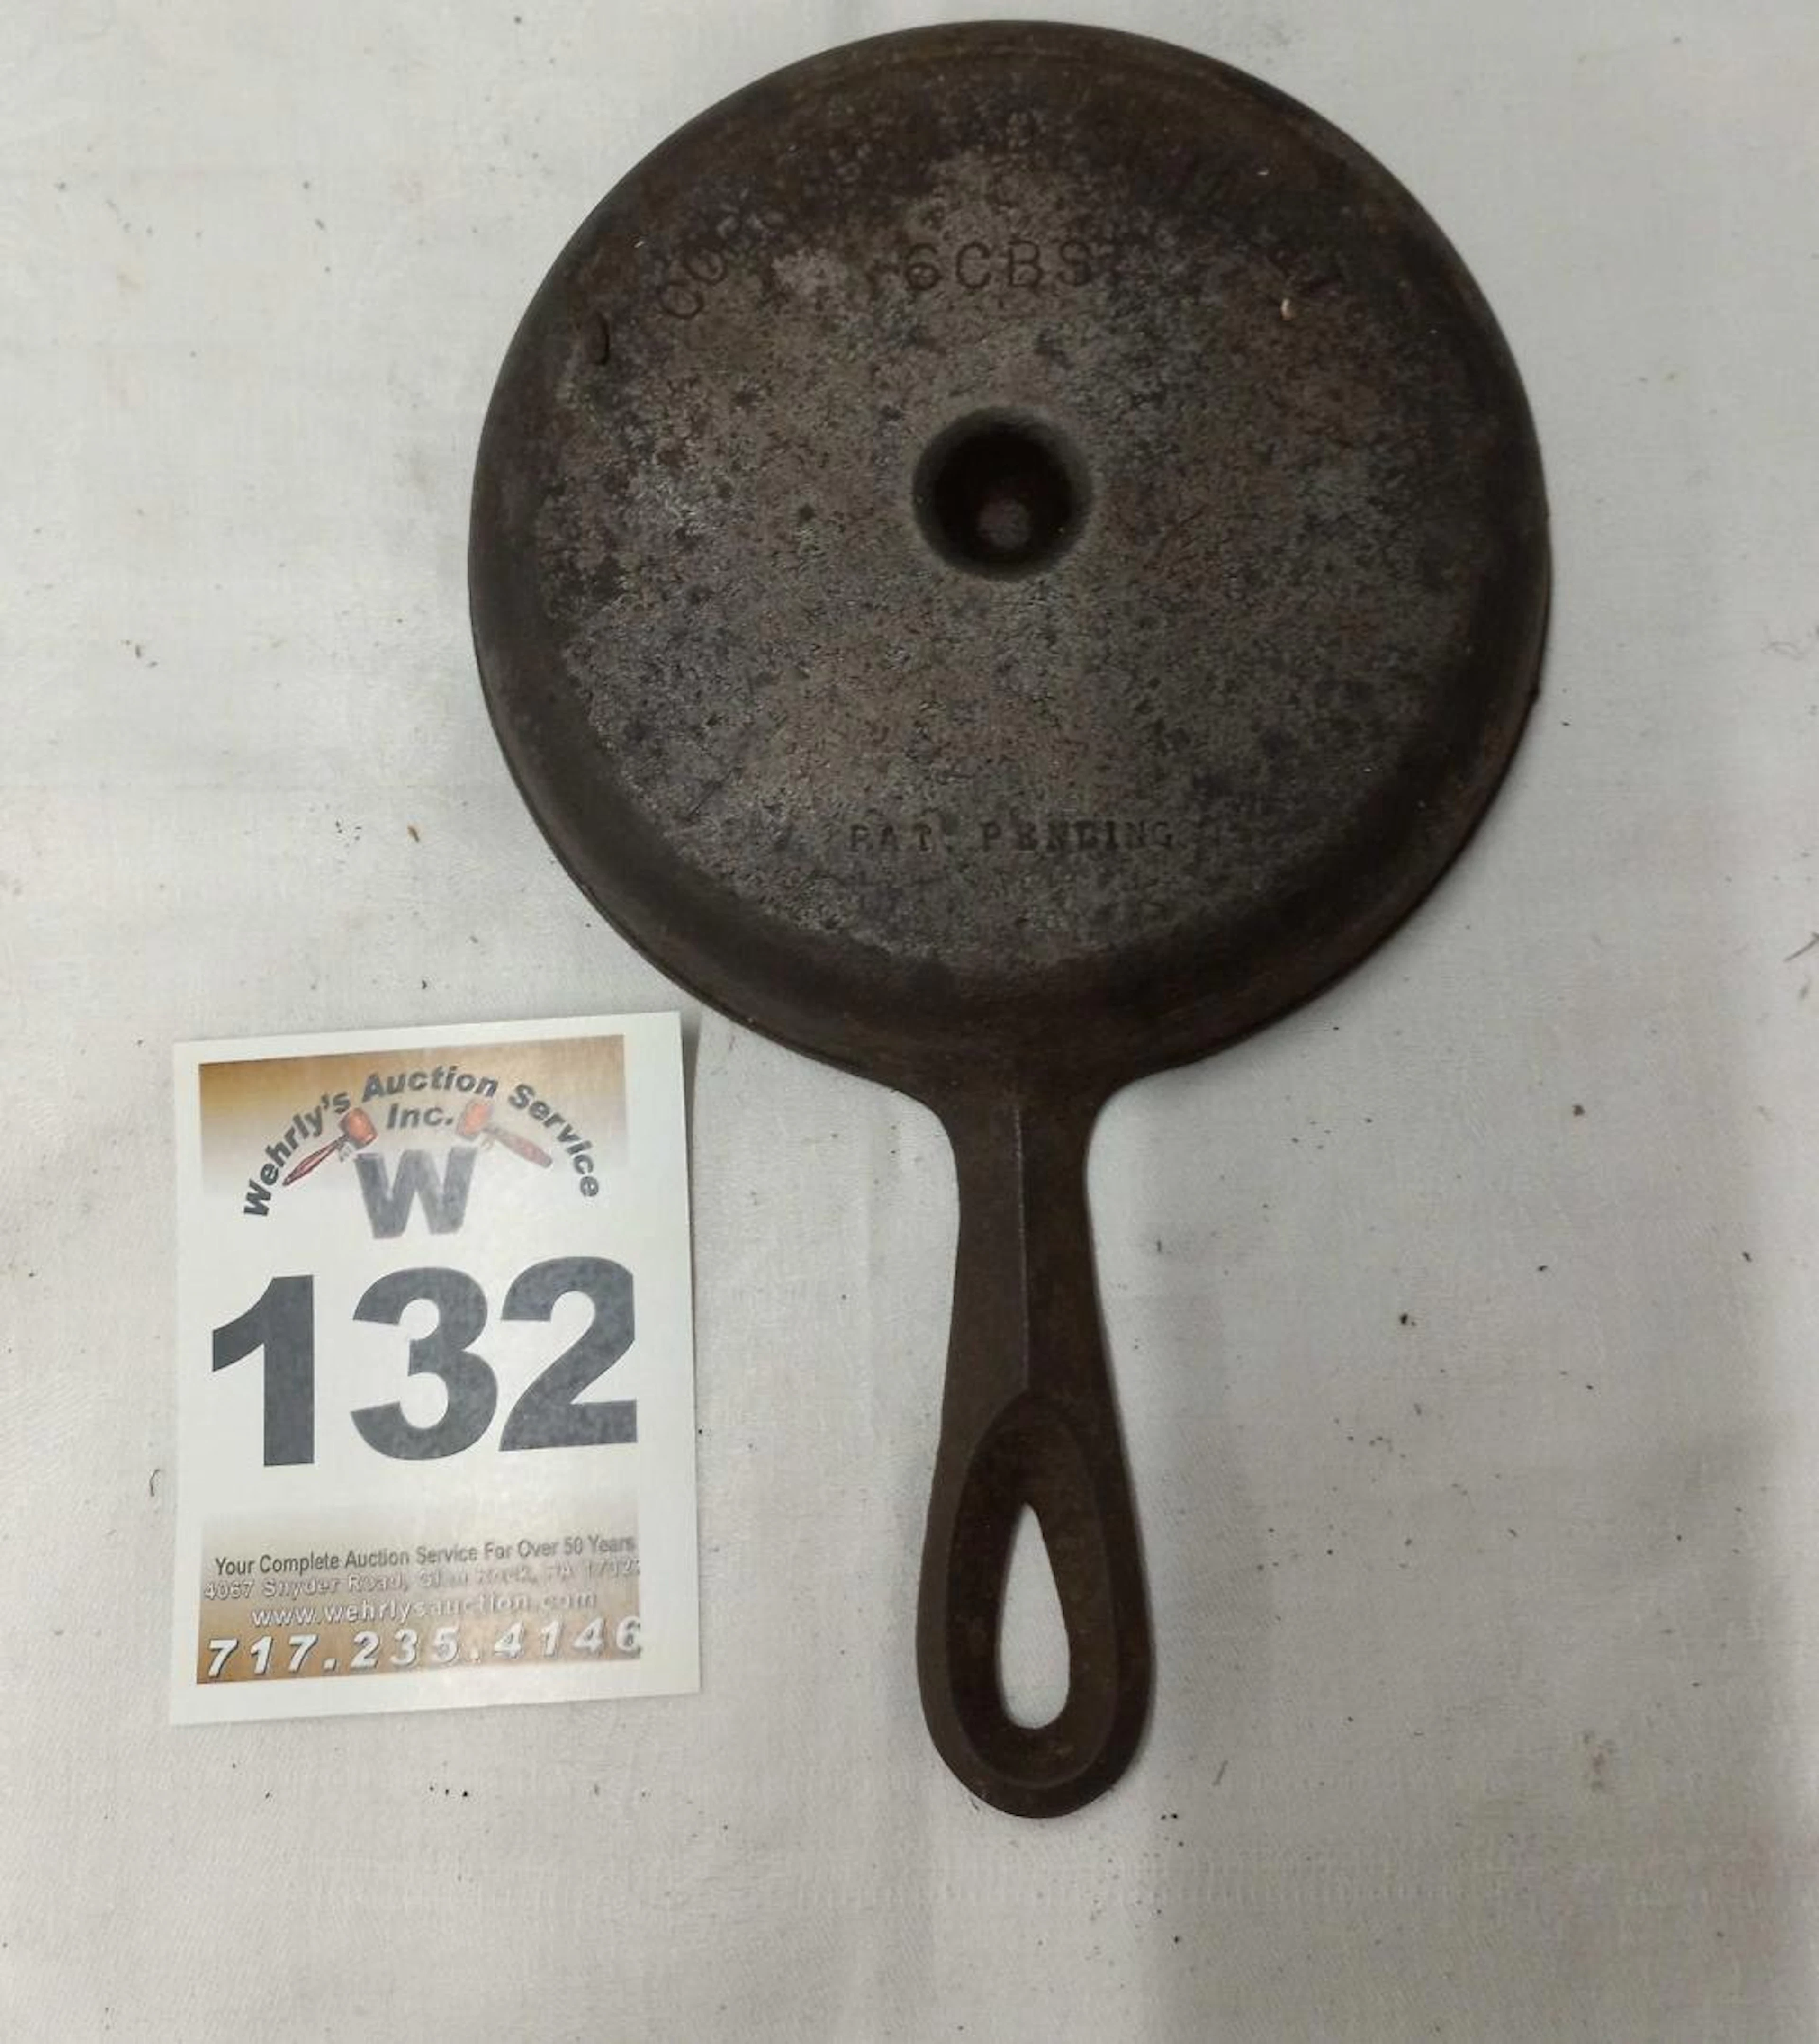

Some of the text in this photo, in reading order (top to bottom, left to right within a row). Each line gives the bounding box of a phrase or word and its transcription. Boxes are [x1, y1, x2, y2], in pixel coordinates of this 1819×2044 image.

[980, 819, 1174, 852] PENDING
[386, 1102, 454, 1130] Inc.
[243, 1065, 600, 1217] Wehrly's Auction Service
[354, 1147, 478, 1239] W
[213, 1256, 638, 1466] 132
[216, 1534, 636, 1576] Your Complete Auction Service For Over 50 Years
[204, 1582, 254, 1600] 4067
[263, 1577, 338, 1600] Snyder
